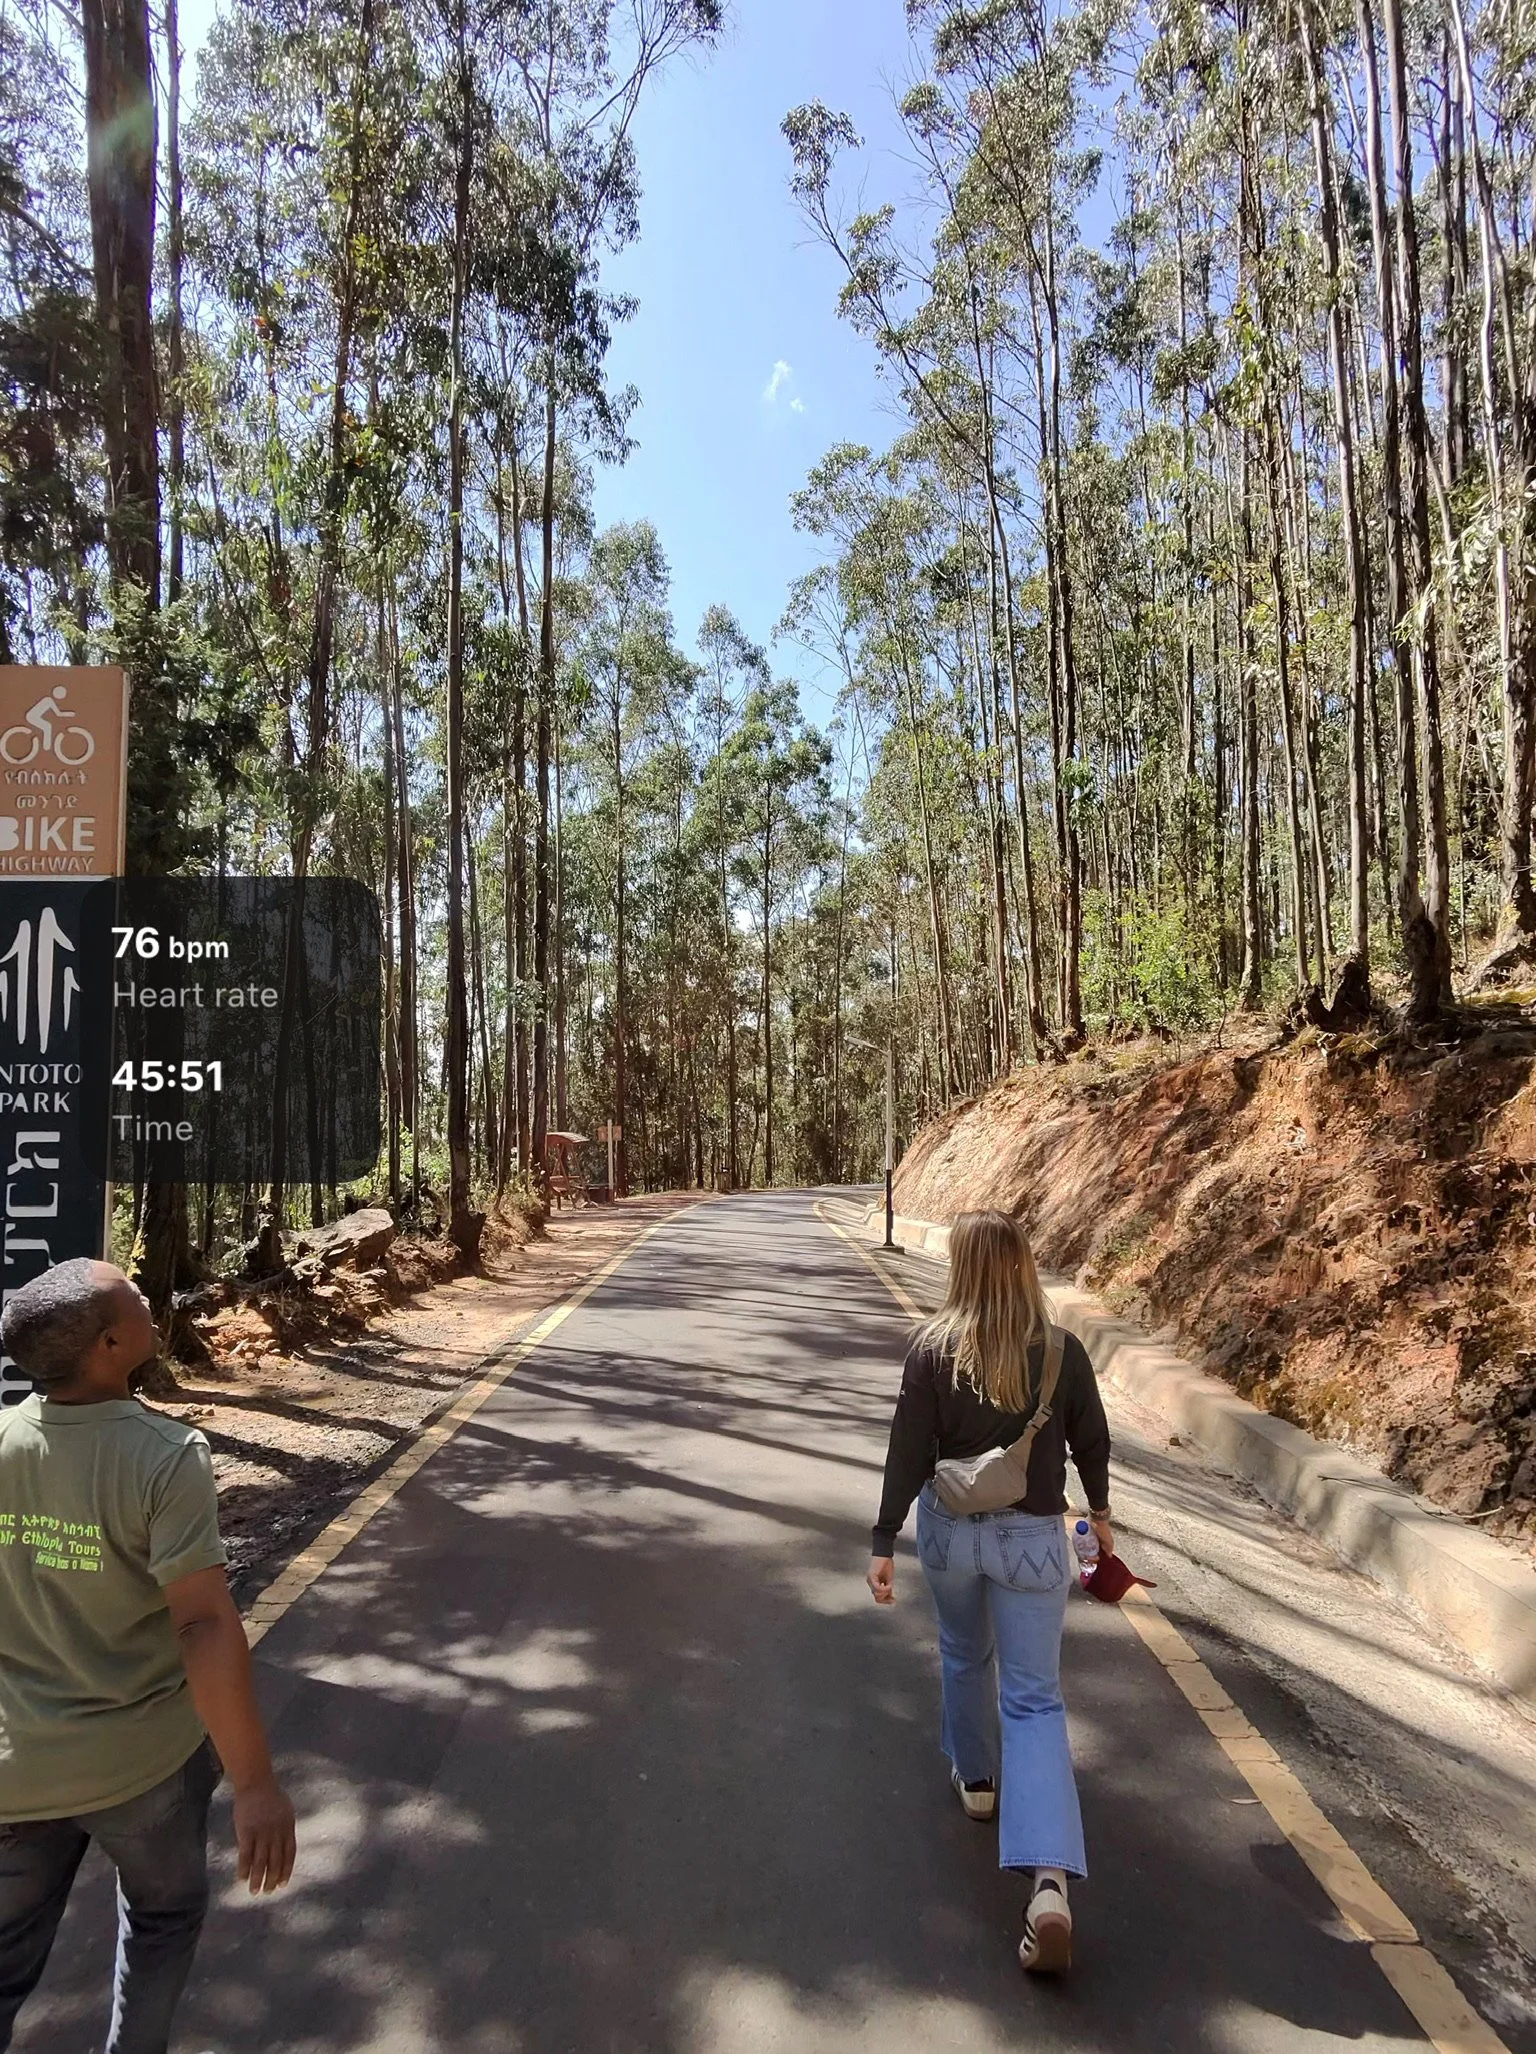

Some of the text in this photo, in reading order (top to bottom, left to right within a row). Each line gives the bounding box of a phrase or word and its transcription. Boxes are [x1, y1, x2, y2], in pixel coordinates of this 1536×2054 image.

[0, 816, 96, 852] BIKE
[0, 1091, 71, 1113] PARK
[68, 1541, 100, 1556] Tours
